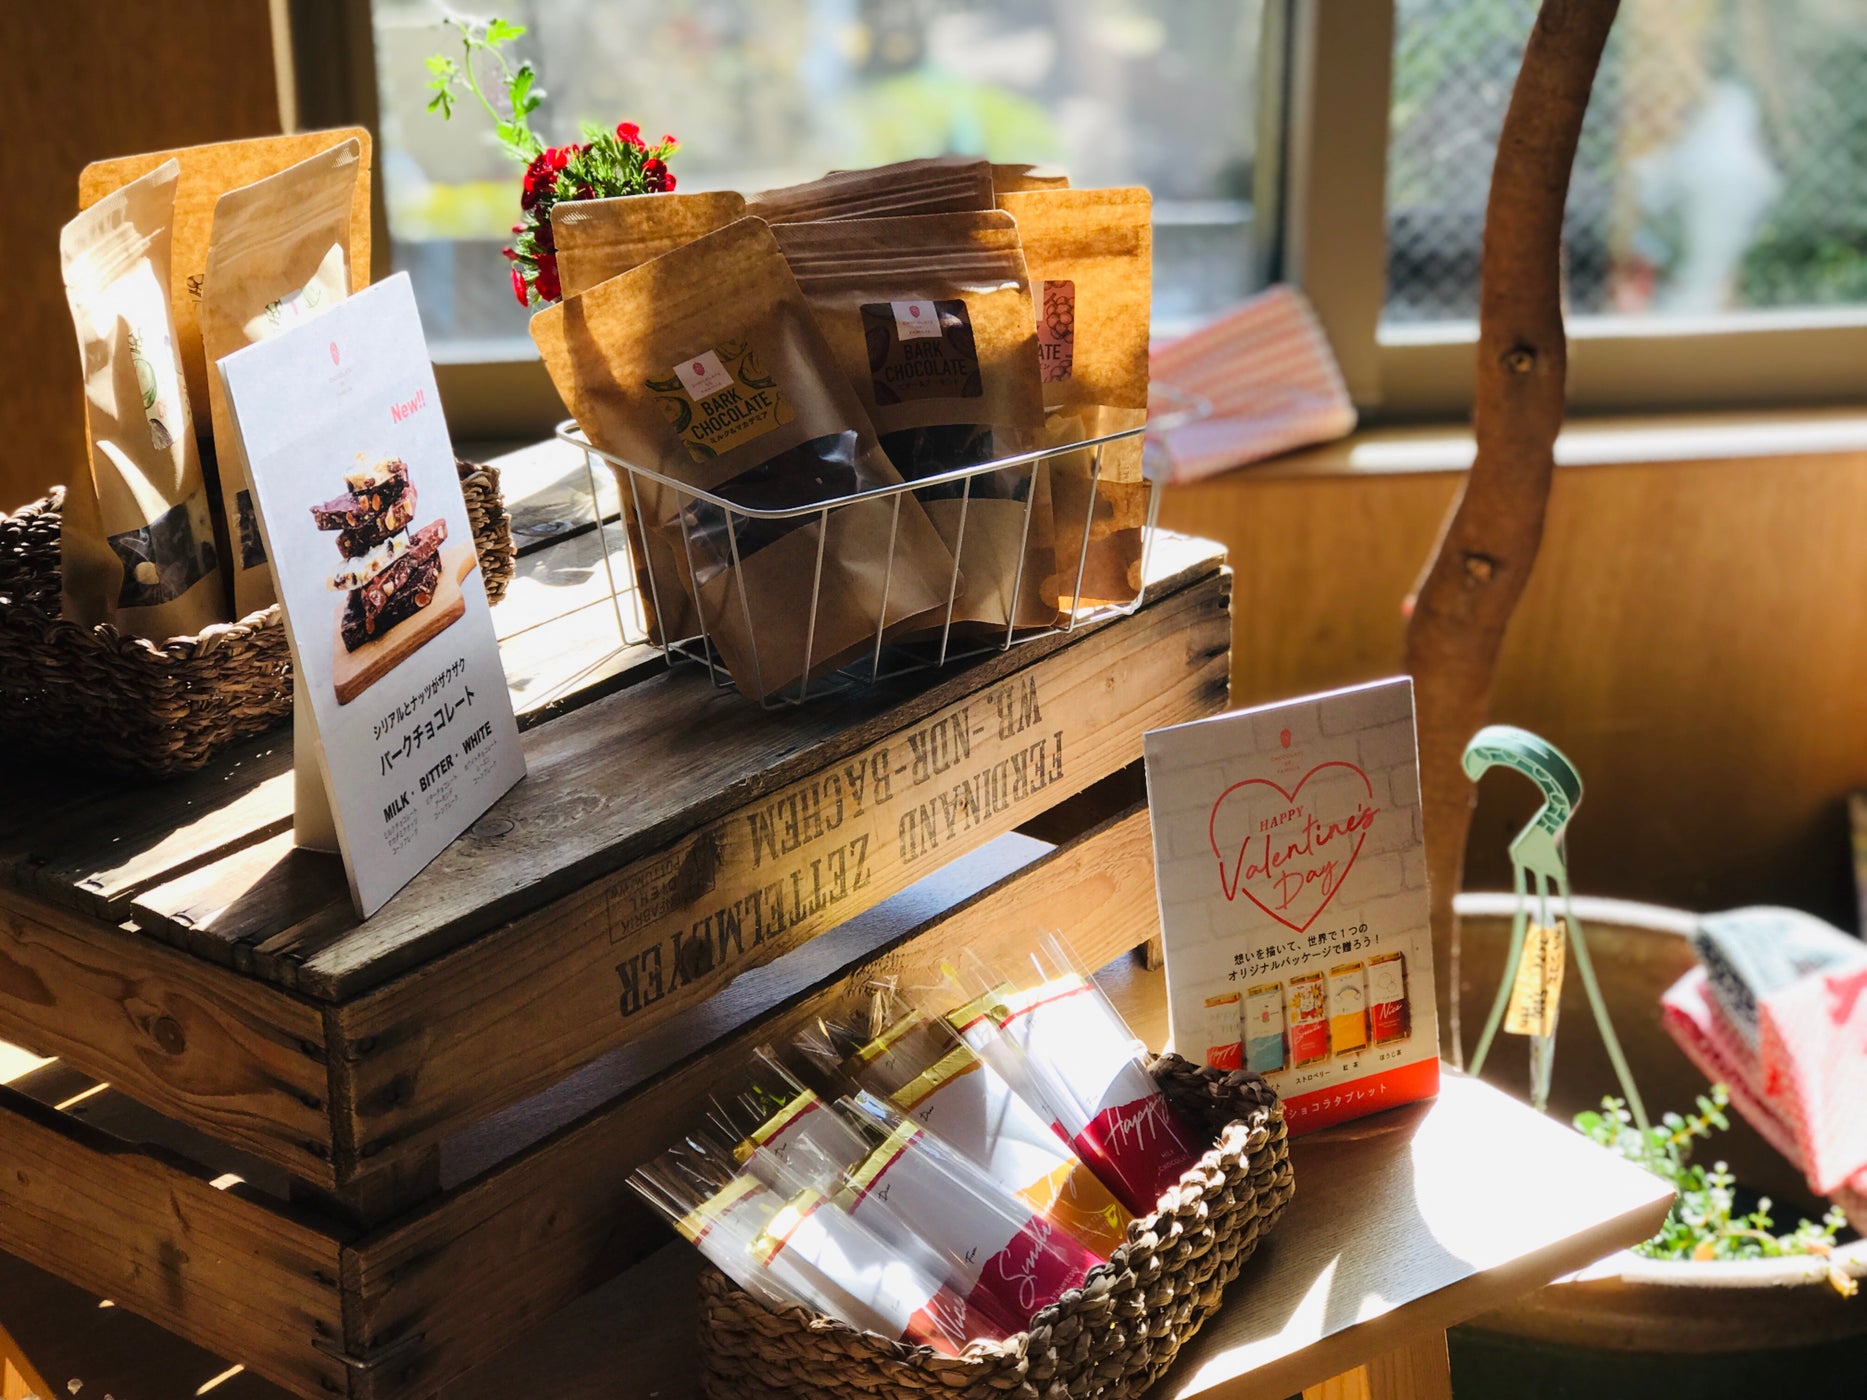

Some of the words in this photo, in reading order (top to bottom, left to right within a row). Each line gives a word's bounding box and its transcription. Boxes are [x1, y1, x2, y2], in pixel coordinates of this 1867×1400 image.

[885, 360, 967, 382] CHOCOLATE
[904, 341, 944, 360] BARK
[390, 388, 426, 424] New!!
[691, 391, 773, 440] CHOCOLATE
[701, 388, 743, 416] BARK
[374, 658, 465, 740] シリアルとナッツがザクザク
[380, 685, 475, 776] バークチョコレート
[383, 791, 410, 823] MILK
[419, 754, 454, 792] BITTER
[462, 721, 493, 754] WHITE
[899, 730, 1065, 866] FERDINAND
[1259, 805, 1304, 832] HAPPY
[1219, 803, 1381, 901] Valentine's
[1273, 860, 1338, 910] Day
[615, 833, 871, 1018] ZETTELMEYER
[1283, 1083, 1388, 1119] ショコラタブレット
[1296, 1071, 1331, 1085] ストロベリー
[1104, 1093, 1169, 1156] Happy
